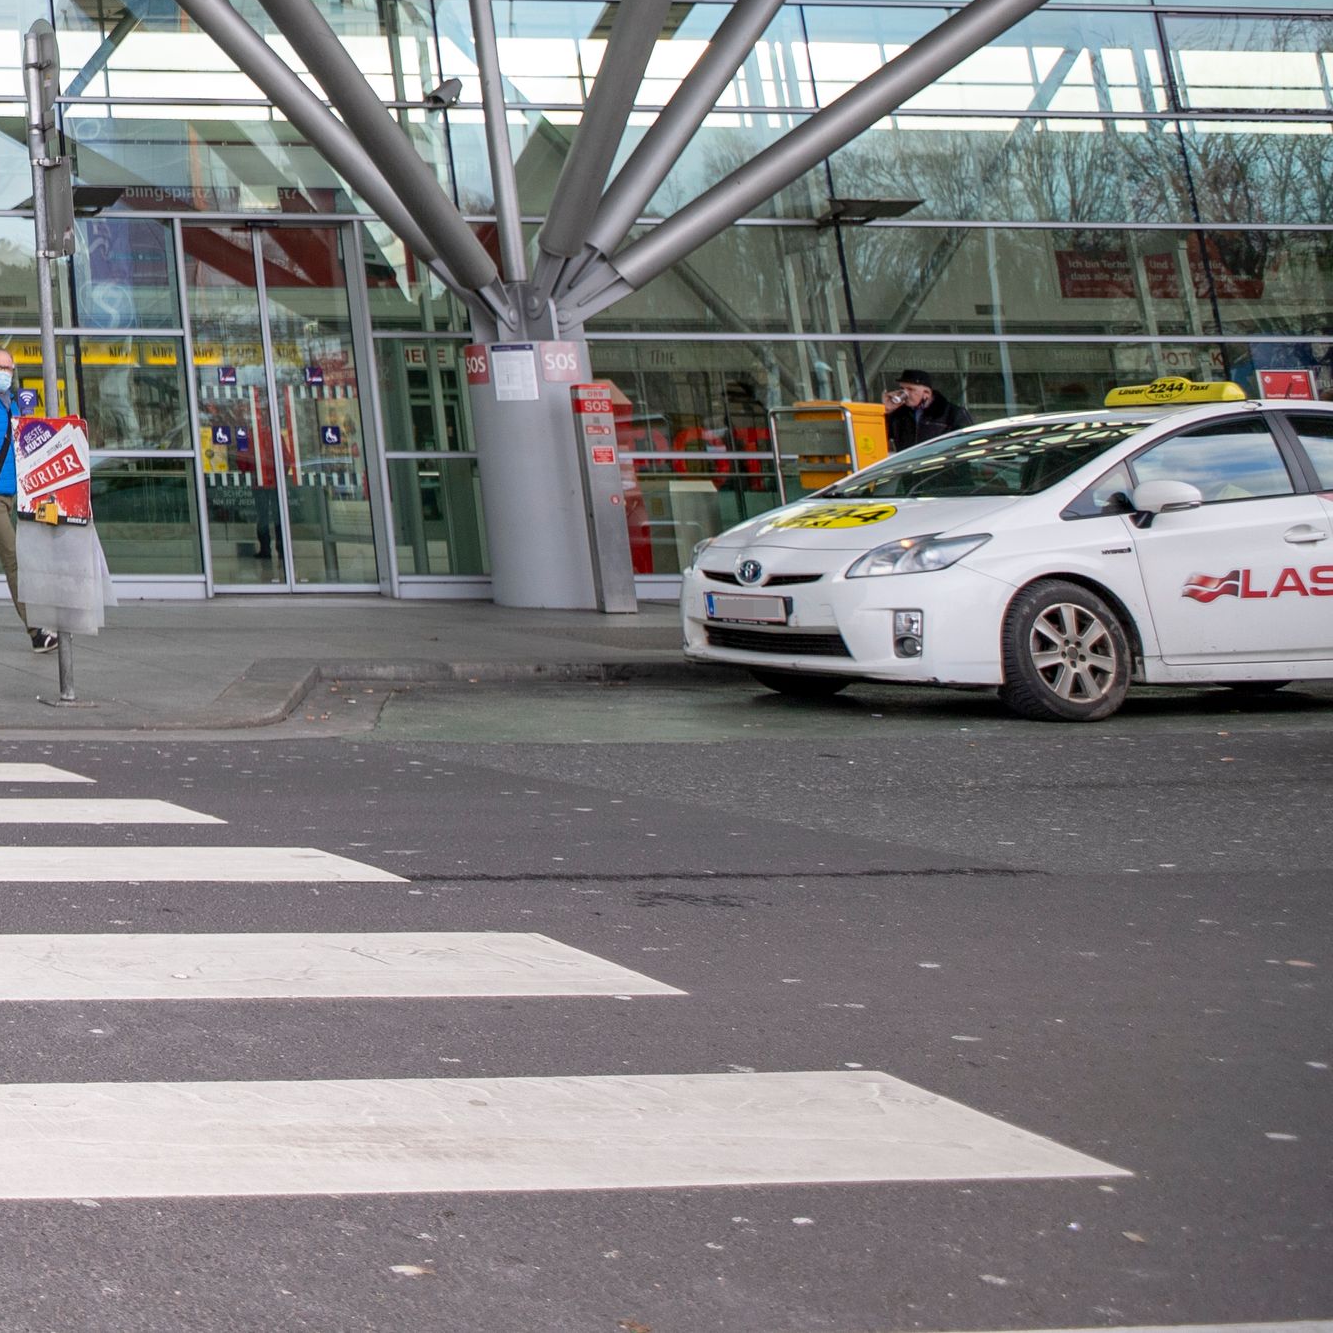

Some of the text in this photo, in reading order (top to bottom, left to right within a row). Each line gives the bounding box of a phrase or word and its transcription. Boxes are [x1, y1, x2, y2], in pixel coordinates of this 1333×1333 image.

[466, 355, 486, 374] SOS
[544, 352, 577, 371] SOS
[1148, 382, 1184, 394] 2244
[1188, 384, 1210, 392] Taxi
[583, 400, 610, 412] SOS
[23, 424, 44, 443] BESTE
[24, 429, 52, 455] KULTUR
[21, 452, 81, 492] KURIER
